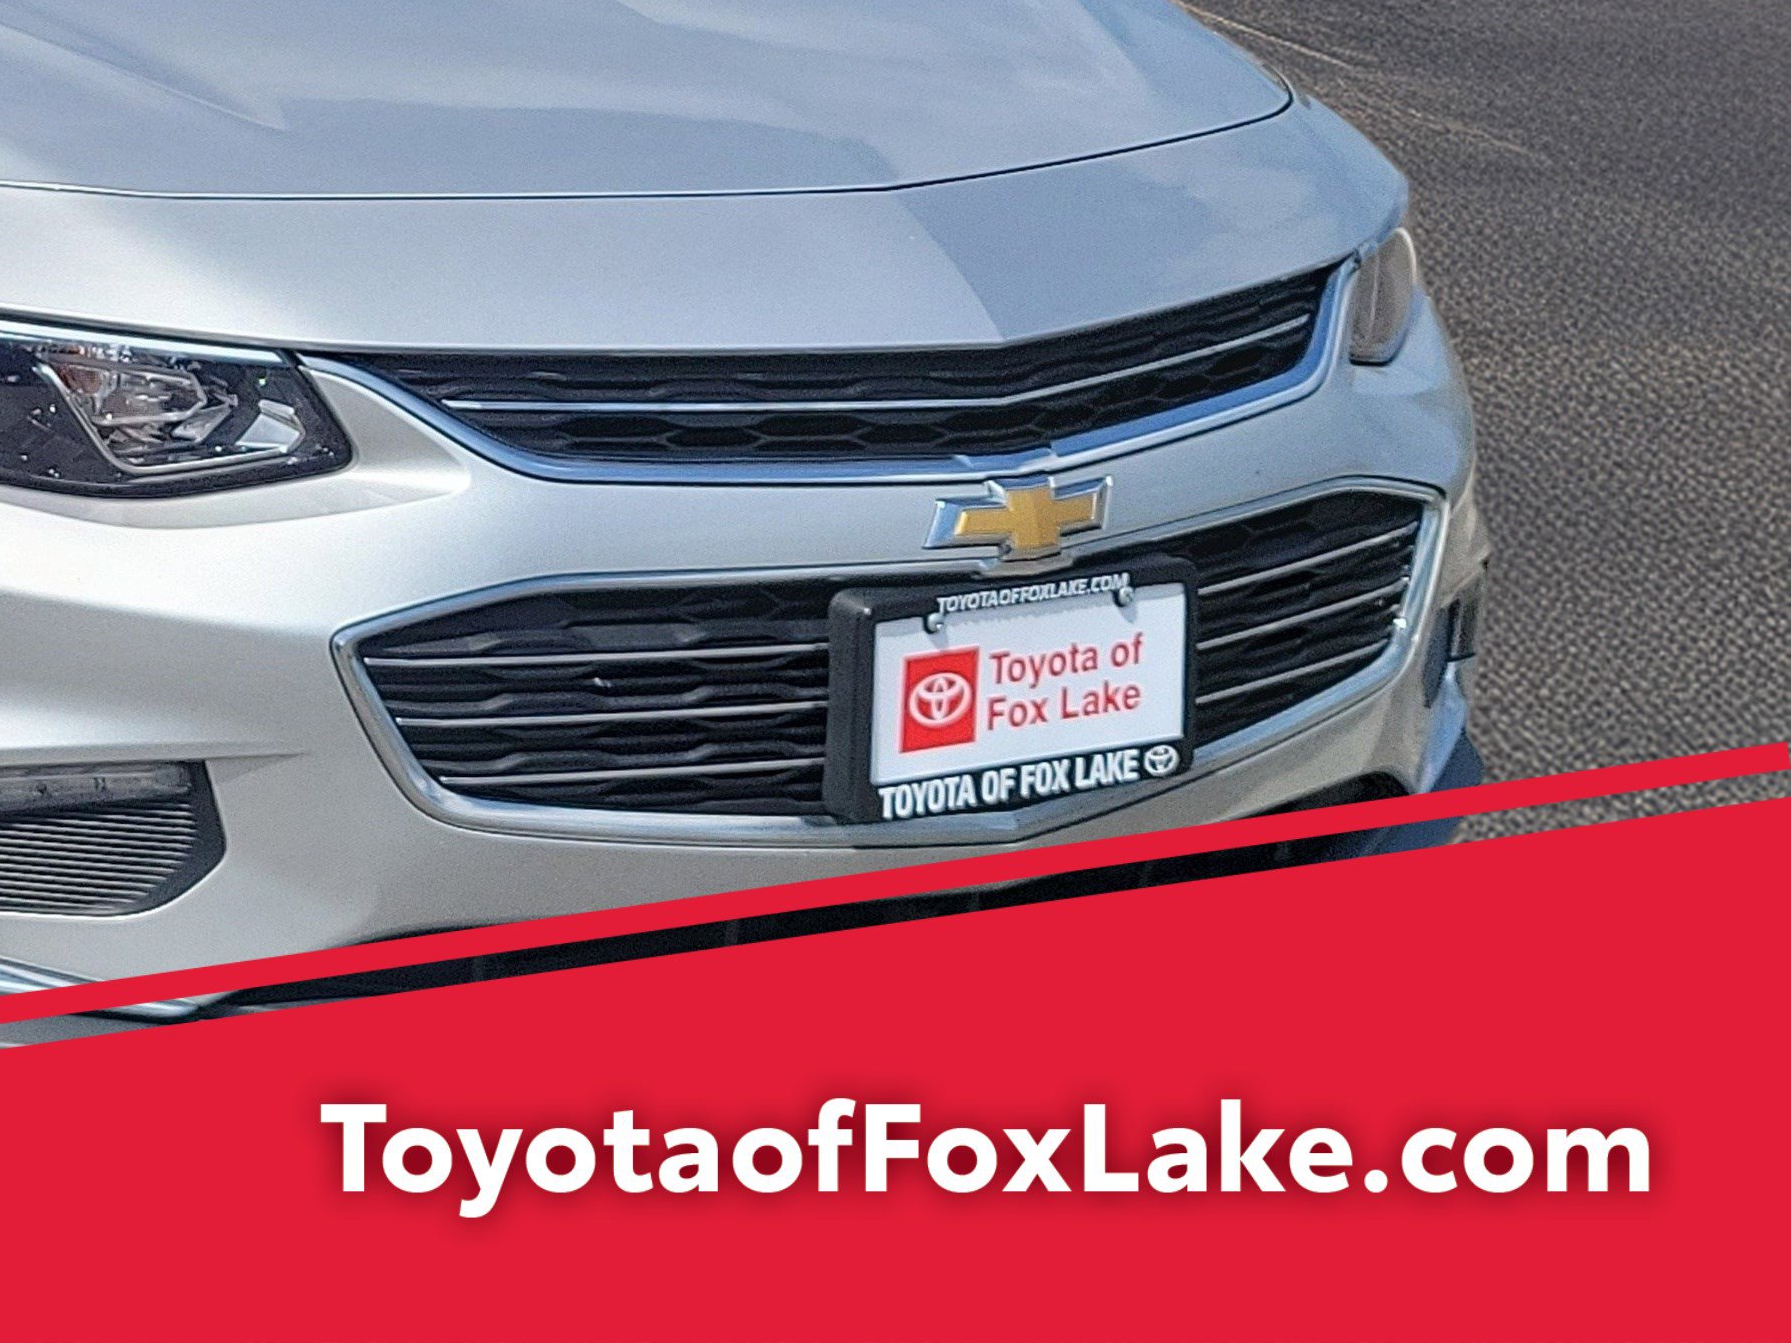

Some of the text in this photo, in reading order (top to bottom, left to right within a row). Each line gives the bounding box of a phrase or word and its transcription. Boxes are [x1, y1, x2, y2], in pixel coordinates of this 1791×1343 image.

[936, 572, 1131, 615] TOYOTAOFFOXLAKE.COM
[990, 632, 1144, 689] Toyota of
[987, 681, 1142, 732] Fox Lake
[878, 748, 1142, 821] TOYOTA OF FOX LAKE
